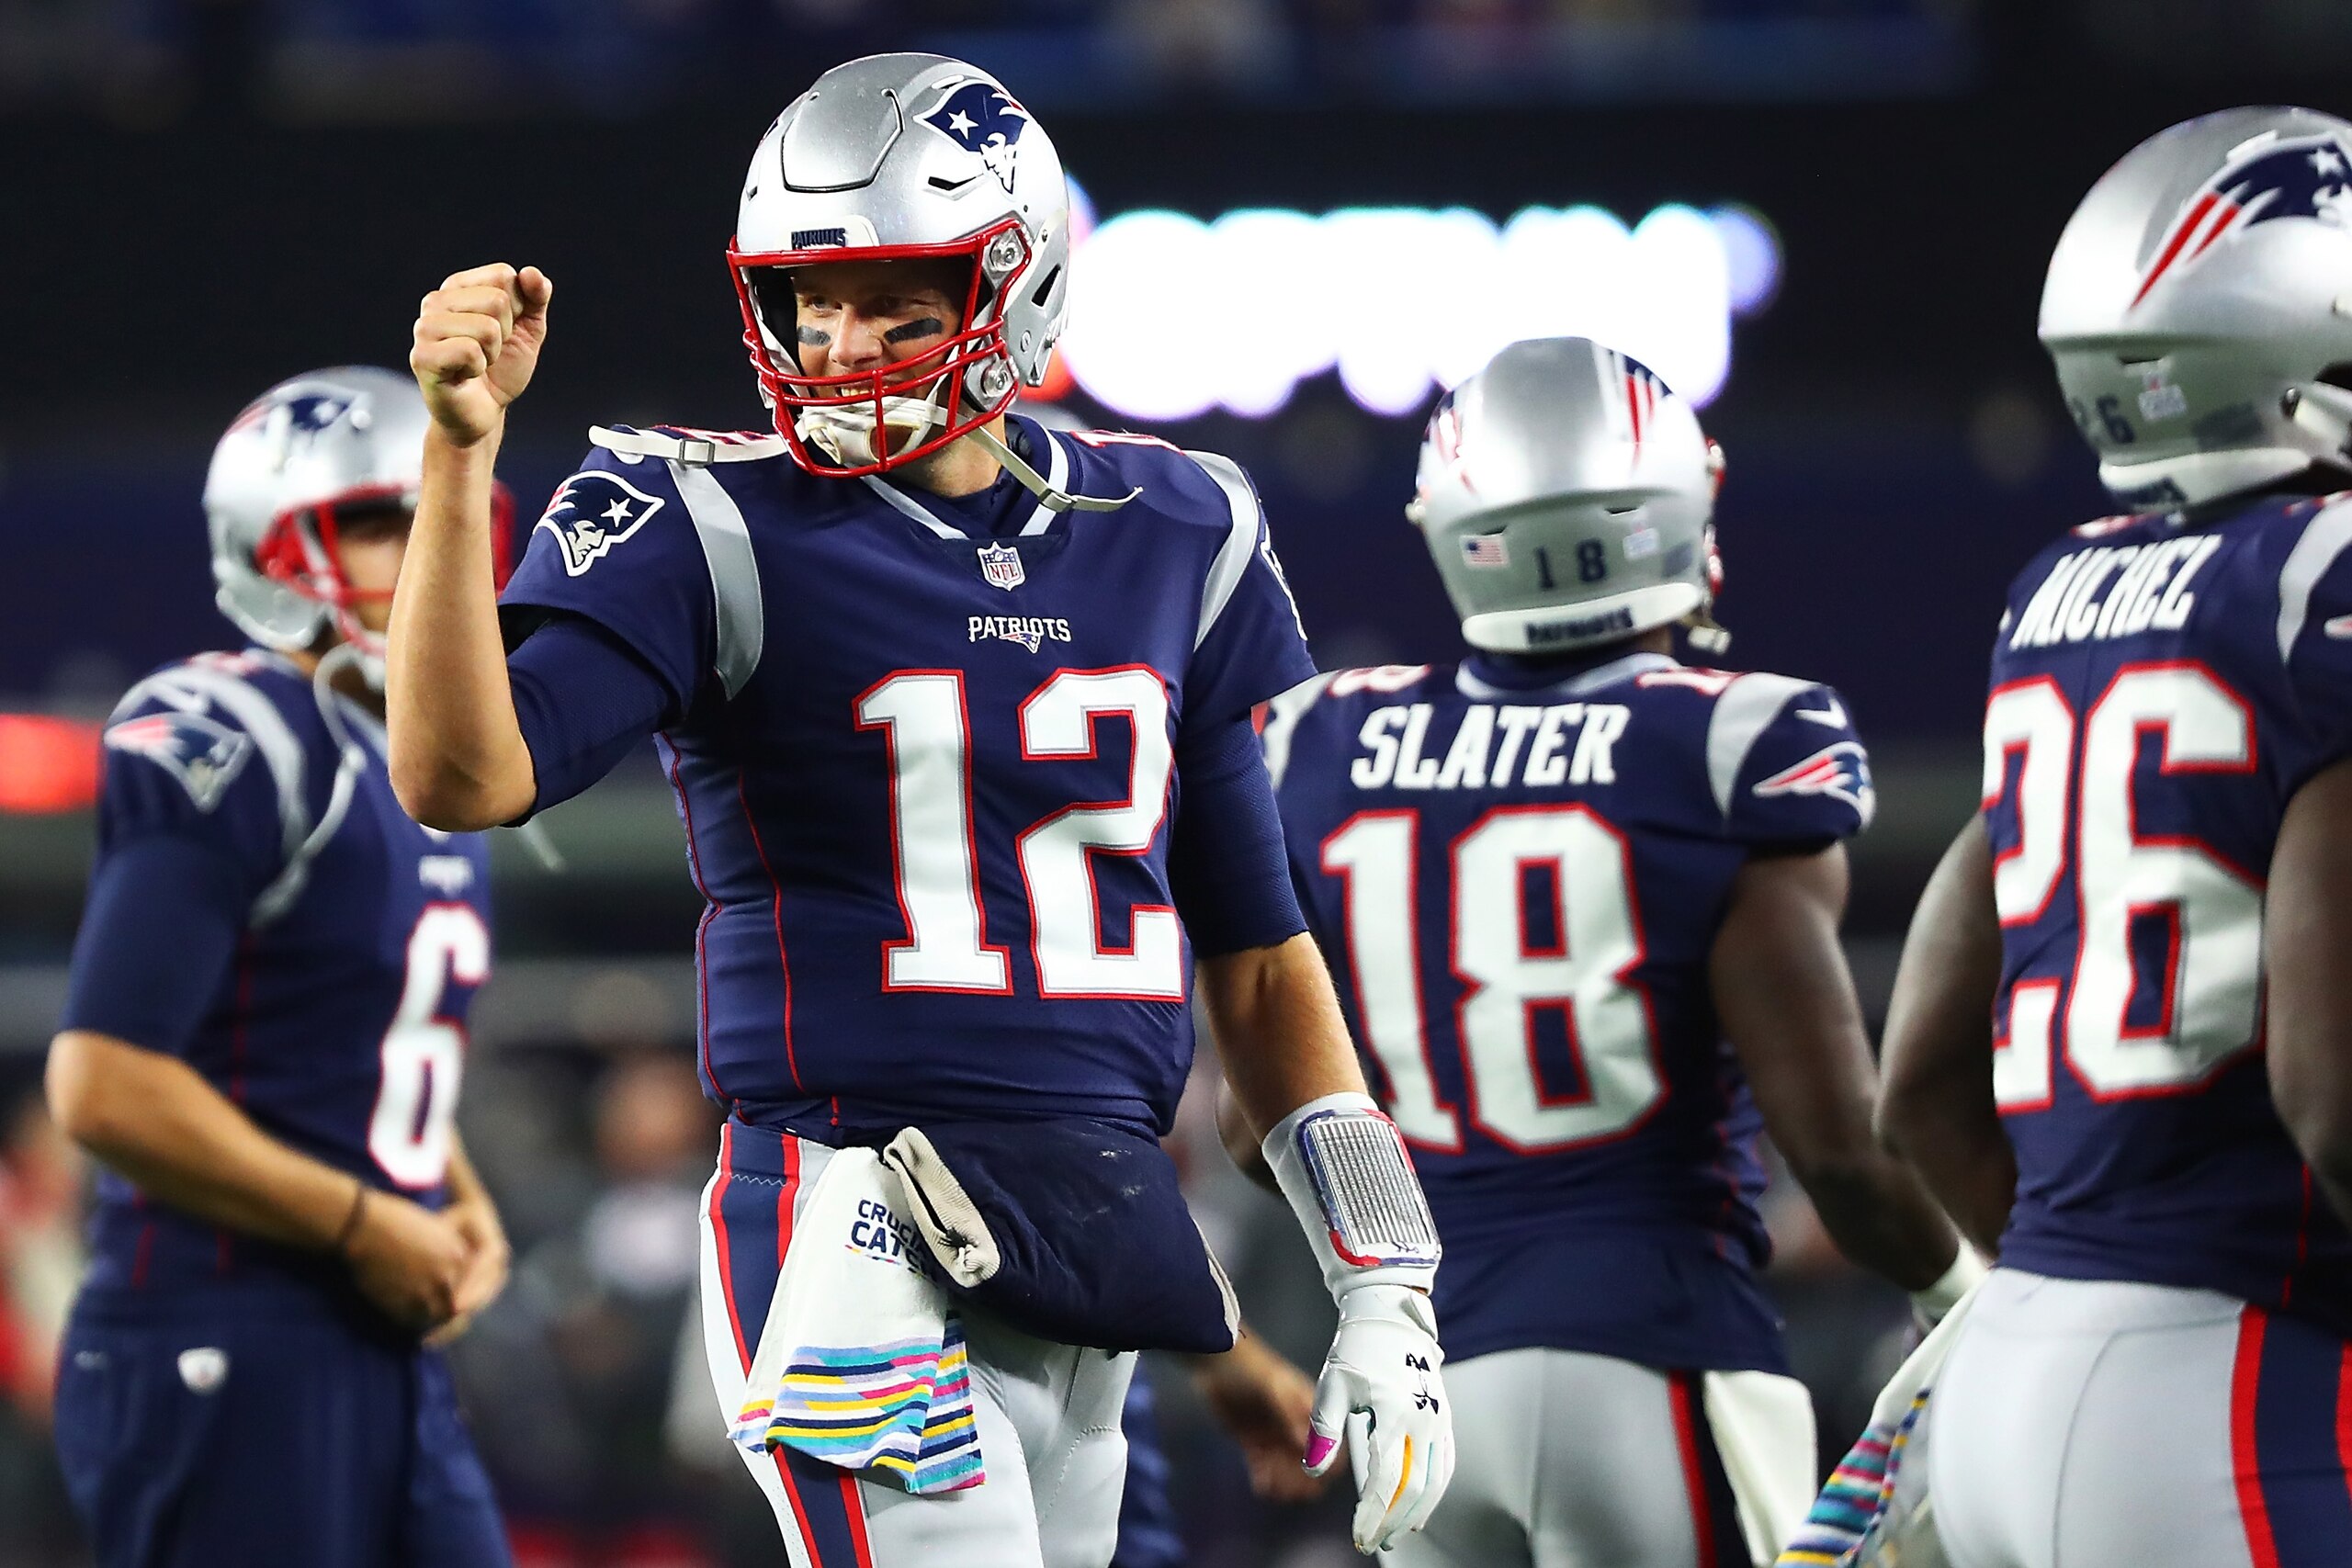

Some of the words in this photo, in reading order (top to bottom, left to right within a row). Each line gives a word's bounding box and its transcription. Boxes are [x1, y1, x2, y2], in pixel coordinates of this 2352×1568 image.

[989, 562, 1018, 581] NFL
[1533, 537, 1607, 591] 18
[2008, 534, 2223, 651] MICHEL
[967, 615, 1072, 643] PATRIOTS
[1350, 703, 1631, 790] SLATER
[851, 662, 1185, 1003] 12
[1982, 659, 2267, 1115] 26
[1319, 801, 1672, 1157] 18
[368, 900, 492, 1190] 6
